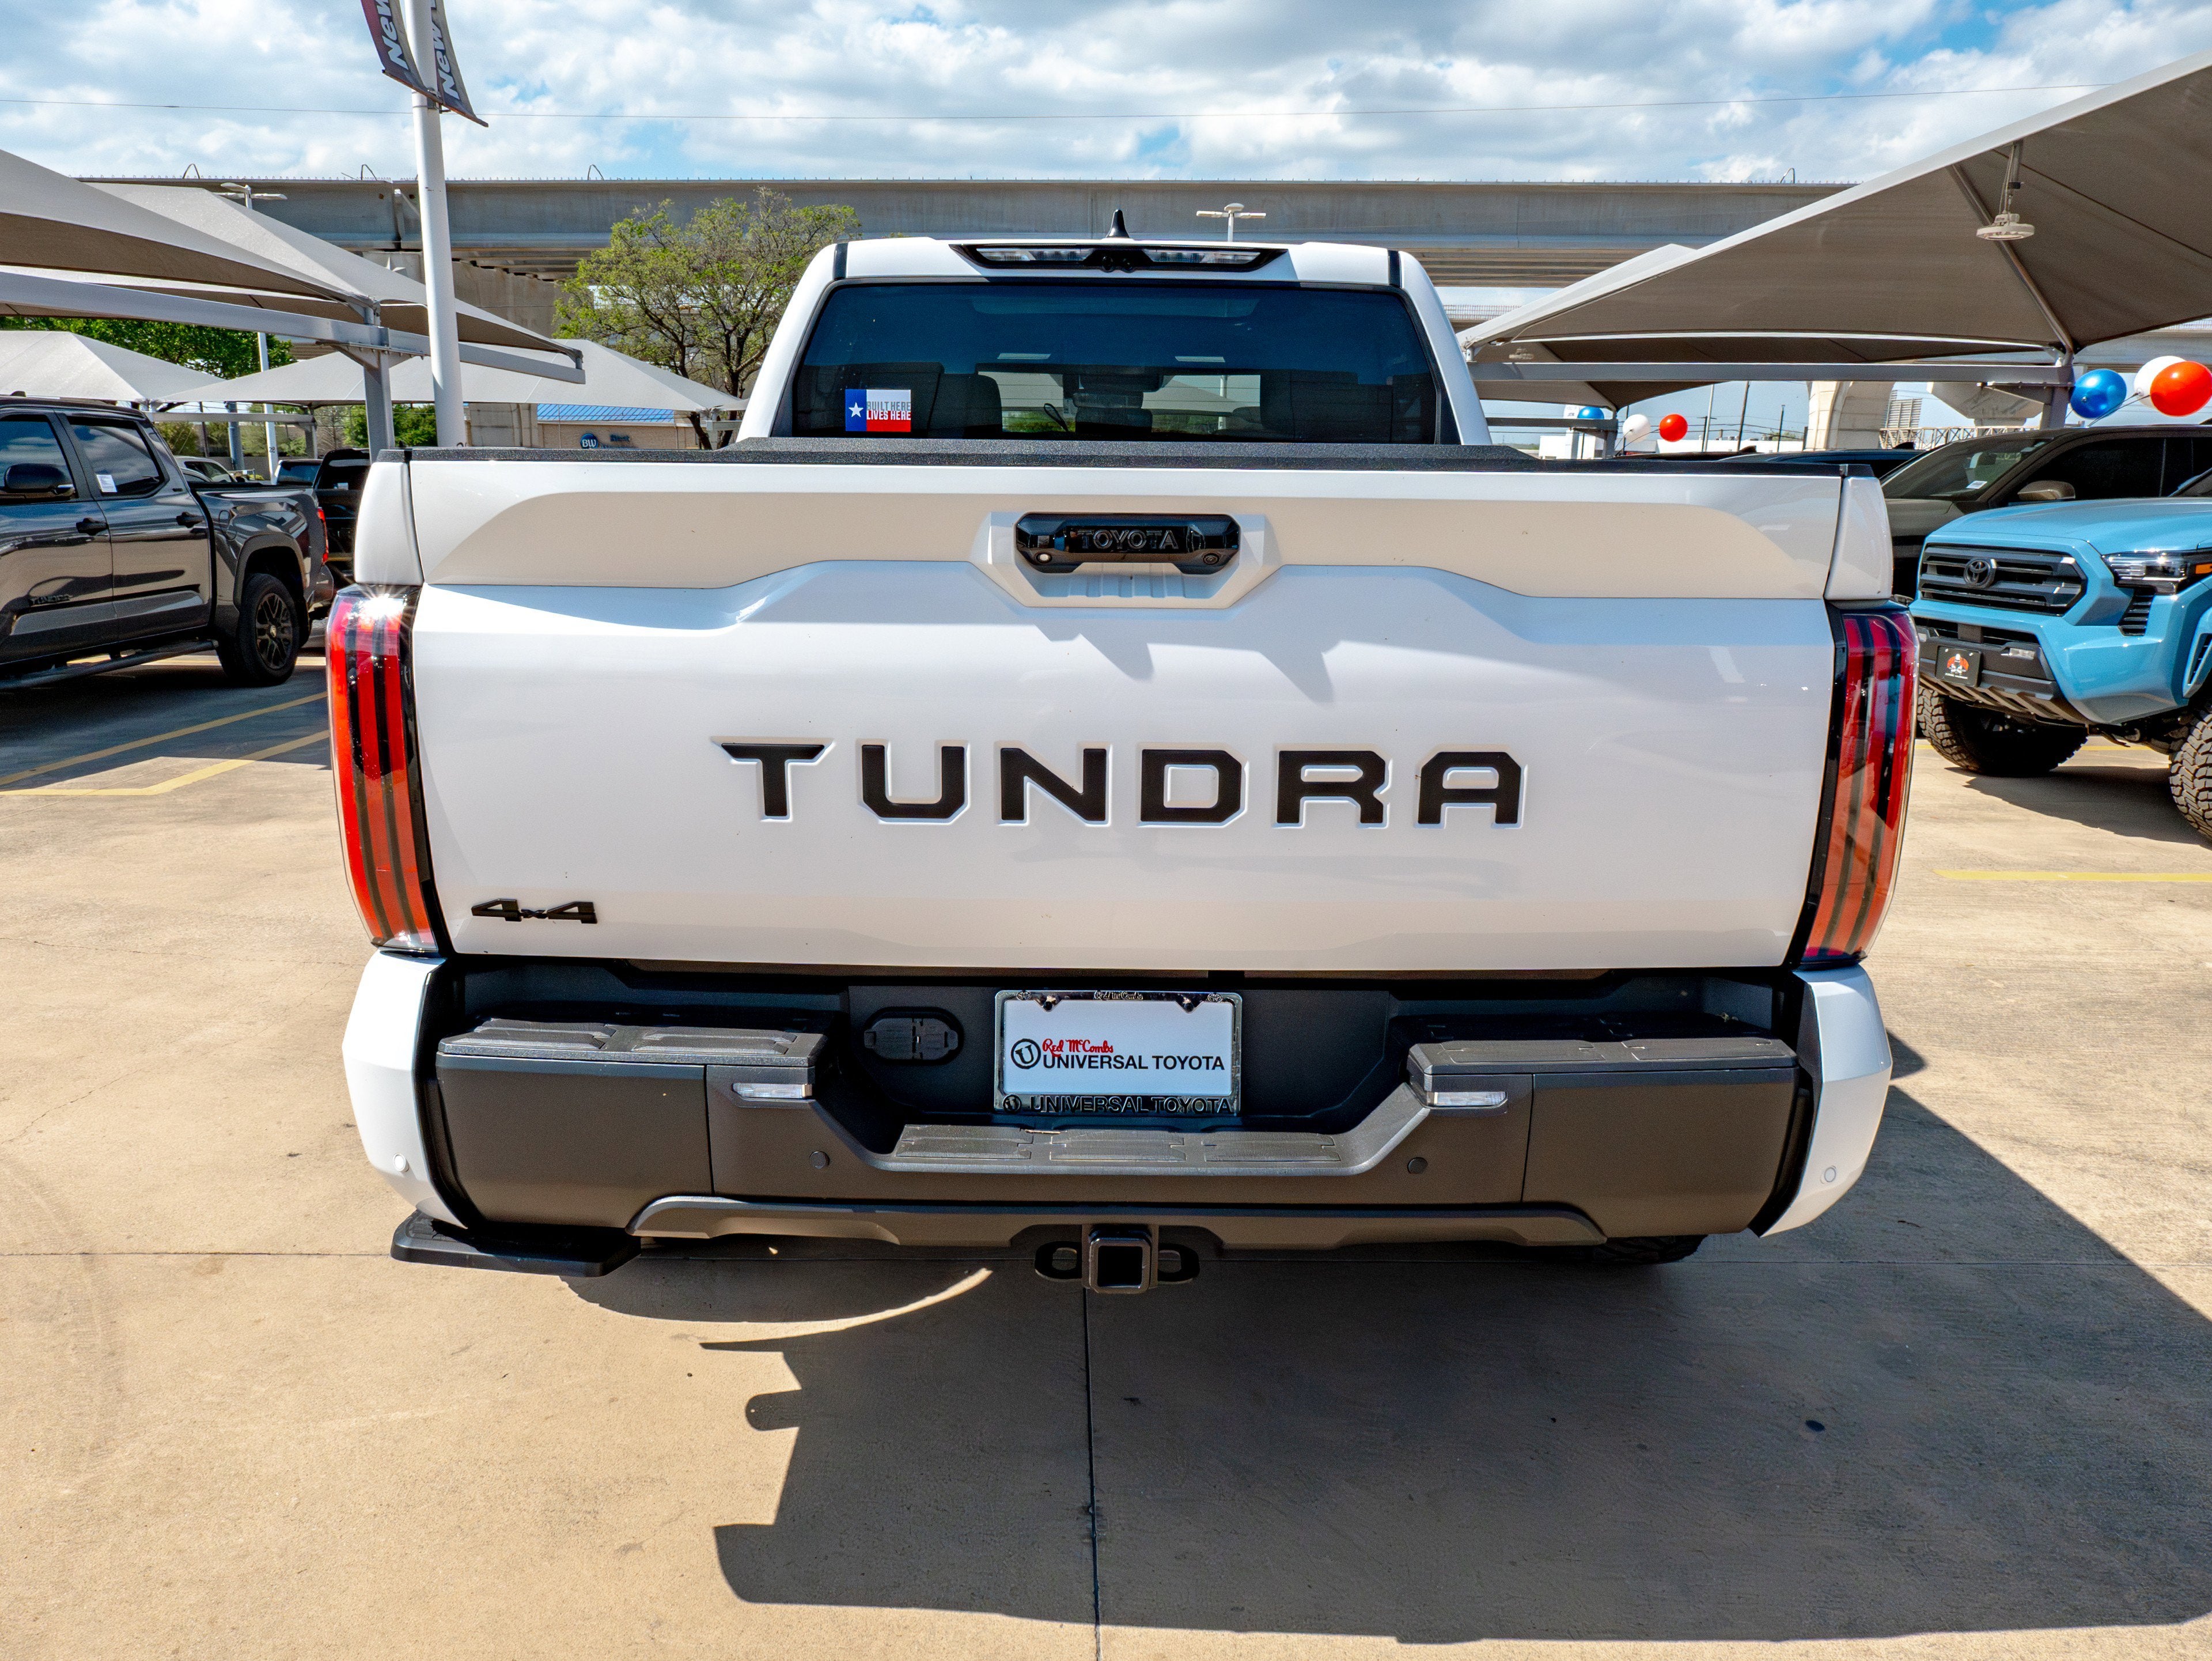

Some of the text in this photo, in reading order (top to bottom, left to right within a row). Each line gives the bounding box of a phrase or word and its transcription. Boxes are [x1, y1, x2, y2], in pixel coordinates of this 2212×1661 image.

[867, 402, 911, 411] BUILT HERE
[866, 411, 911, 420] LIVES HERE
[582, 439, 596, 448] BW
[1078, 529, 1179, 550] TOYOTA
[720, 743, 1523, 825] TUNDRA
[1042, 1038, 1114, 1057] Red McCombs
[1043, 1054, 1225, 1070] UNIVERSAL TOYOTA
[1030, 1096, 1233, 1114] UNIVERSAL TOYOTA
